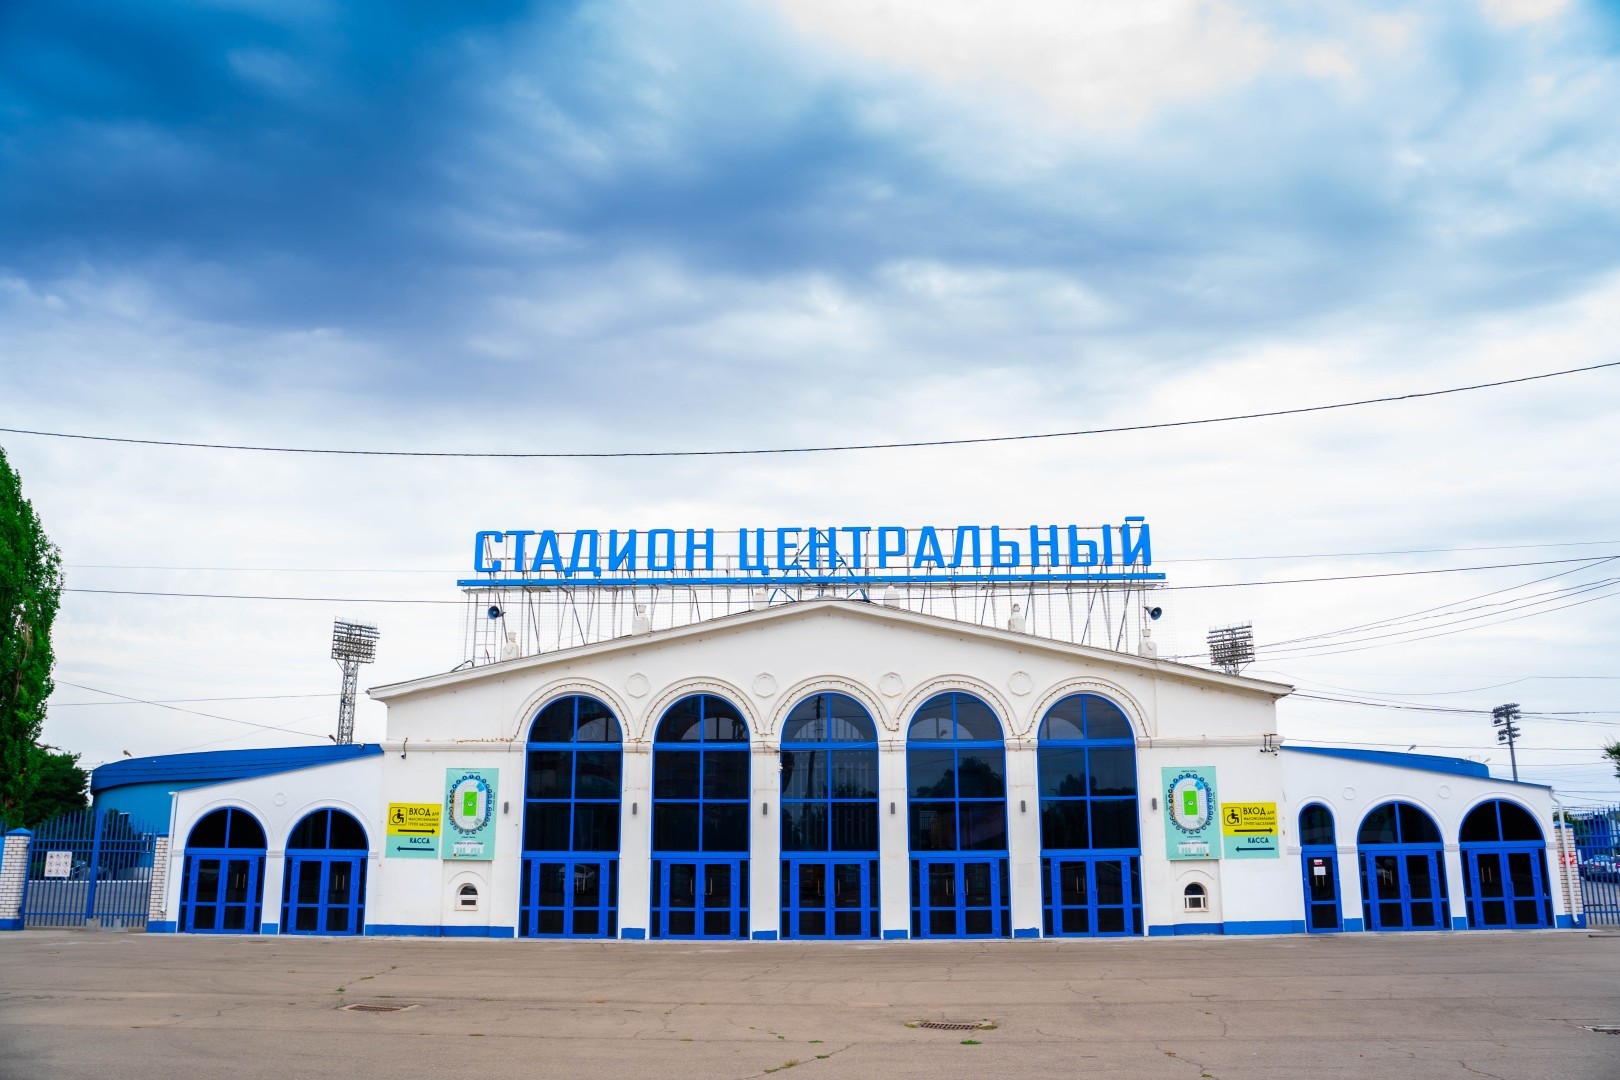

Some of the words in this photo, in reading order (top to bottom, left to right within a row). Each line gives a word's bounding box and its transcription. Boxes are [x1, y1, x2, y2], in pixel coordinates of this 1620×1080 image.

[473, 528, 714, 577] СТАДИОН
[738, 516, 1152, 576] ЦЕНТРАЛЬНЫЙ
[408, 807, 431, 817] ВХОД
[1243, 806, 1266, 816] ВХОД
[1247, 836, 1269, 844] КАССА
